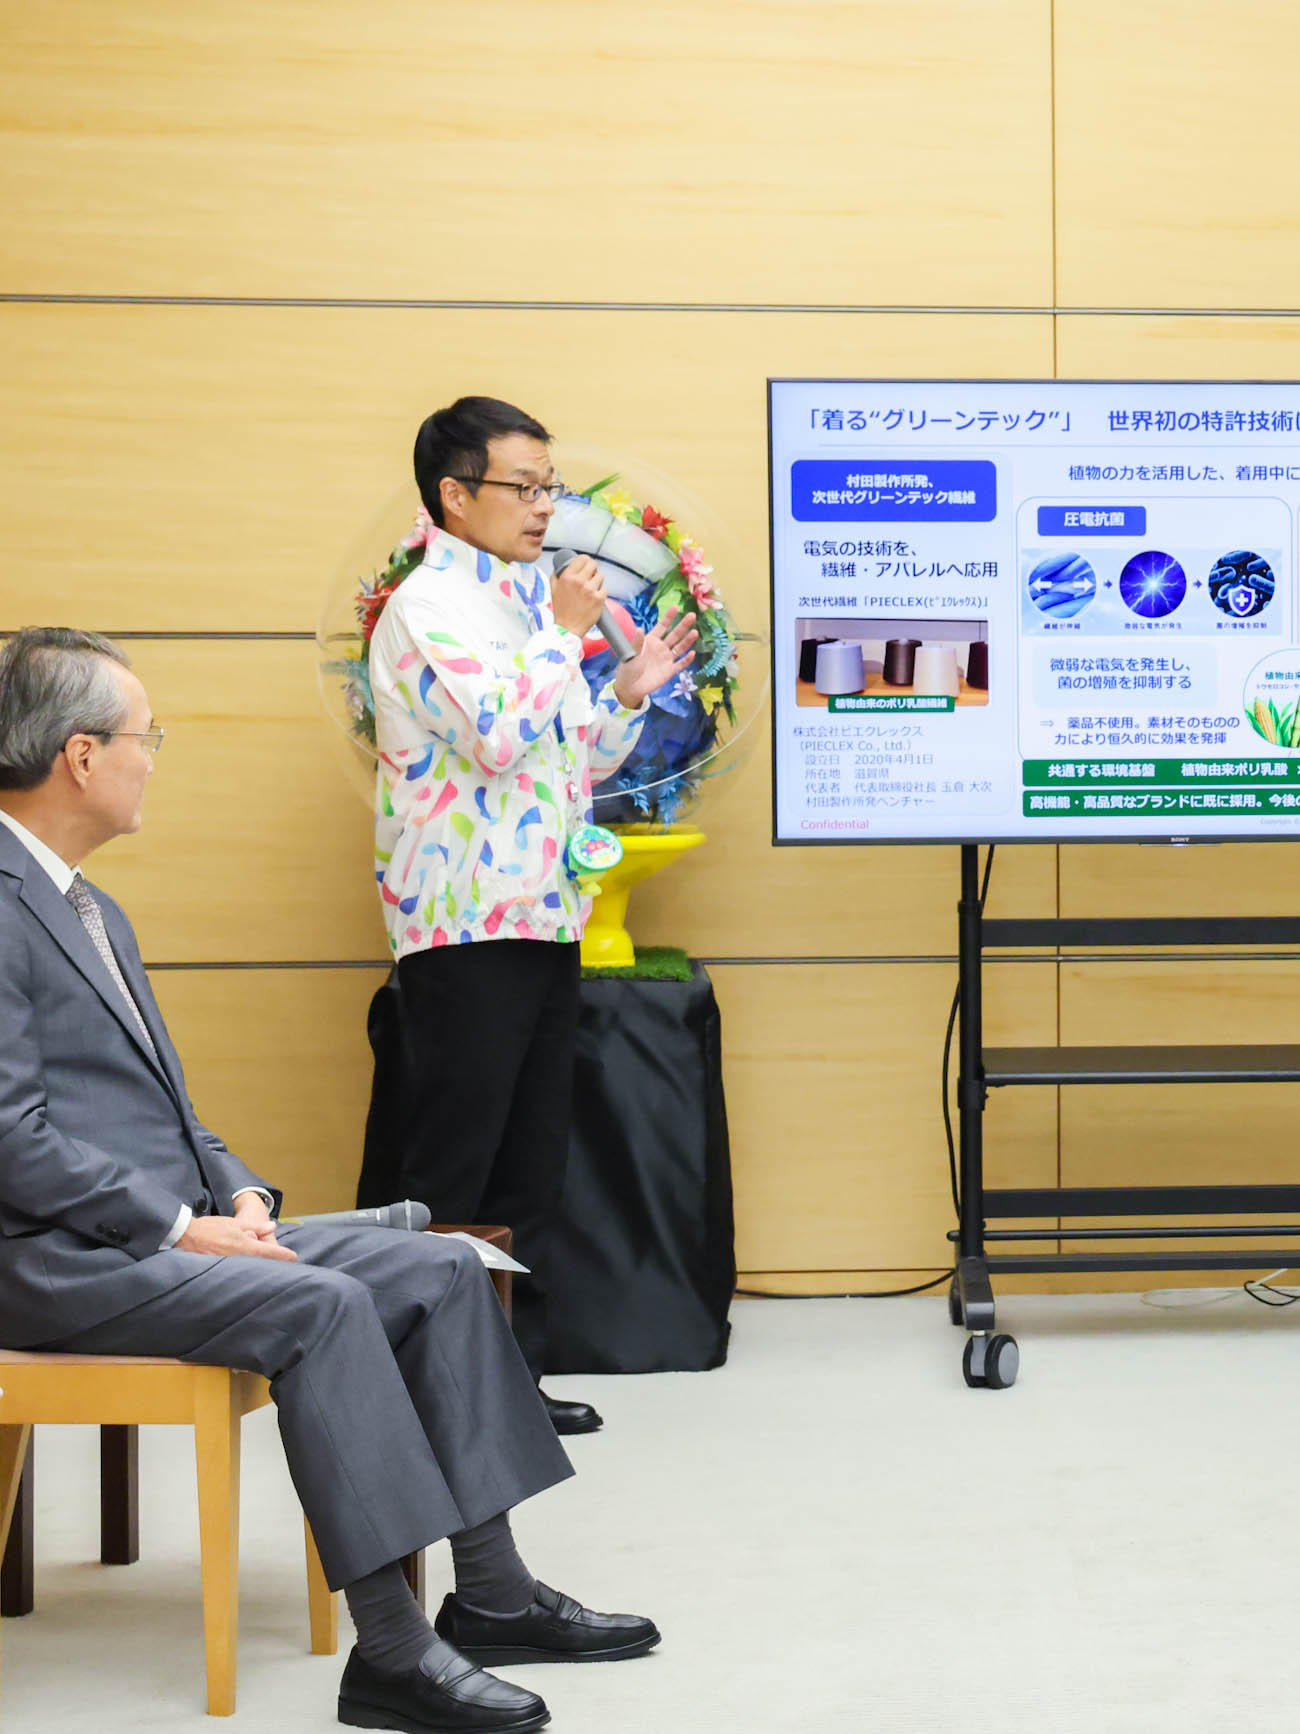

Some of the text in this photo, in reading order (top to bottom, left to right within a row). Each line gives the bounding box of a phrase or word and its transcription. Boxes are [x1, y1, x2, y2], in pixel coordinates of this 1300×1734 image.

[845, 473, 934, 489] 村田製作所発、
[811, 489, 977, 505] 次世代グリーンテック繊維
[1063, 511, 1125, 528] 圧電抗菌
[803, 540, 917, 557] 電気の技術を、
[1049, 657, 1191, 673] 微弱な電気を発生し、
[1057, 674, 1192, 690] 菌の増殖を抑制する
[1054, 731, 1228, 746] 力により恒久的に効果を発揮
[804, 754, 934, 766] 設立日 2020年4月1日
[804, 767, 890, 781] 所在地 滋賀県
[1047, 762, 1156, 778] 共通する環境基盤
[1180, 761, 1289, 777] 植物由来ポリ乳酸
[805, 781, 841, 795] 代表者
[800, 819, 870, 830] Confidential
